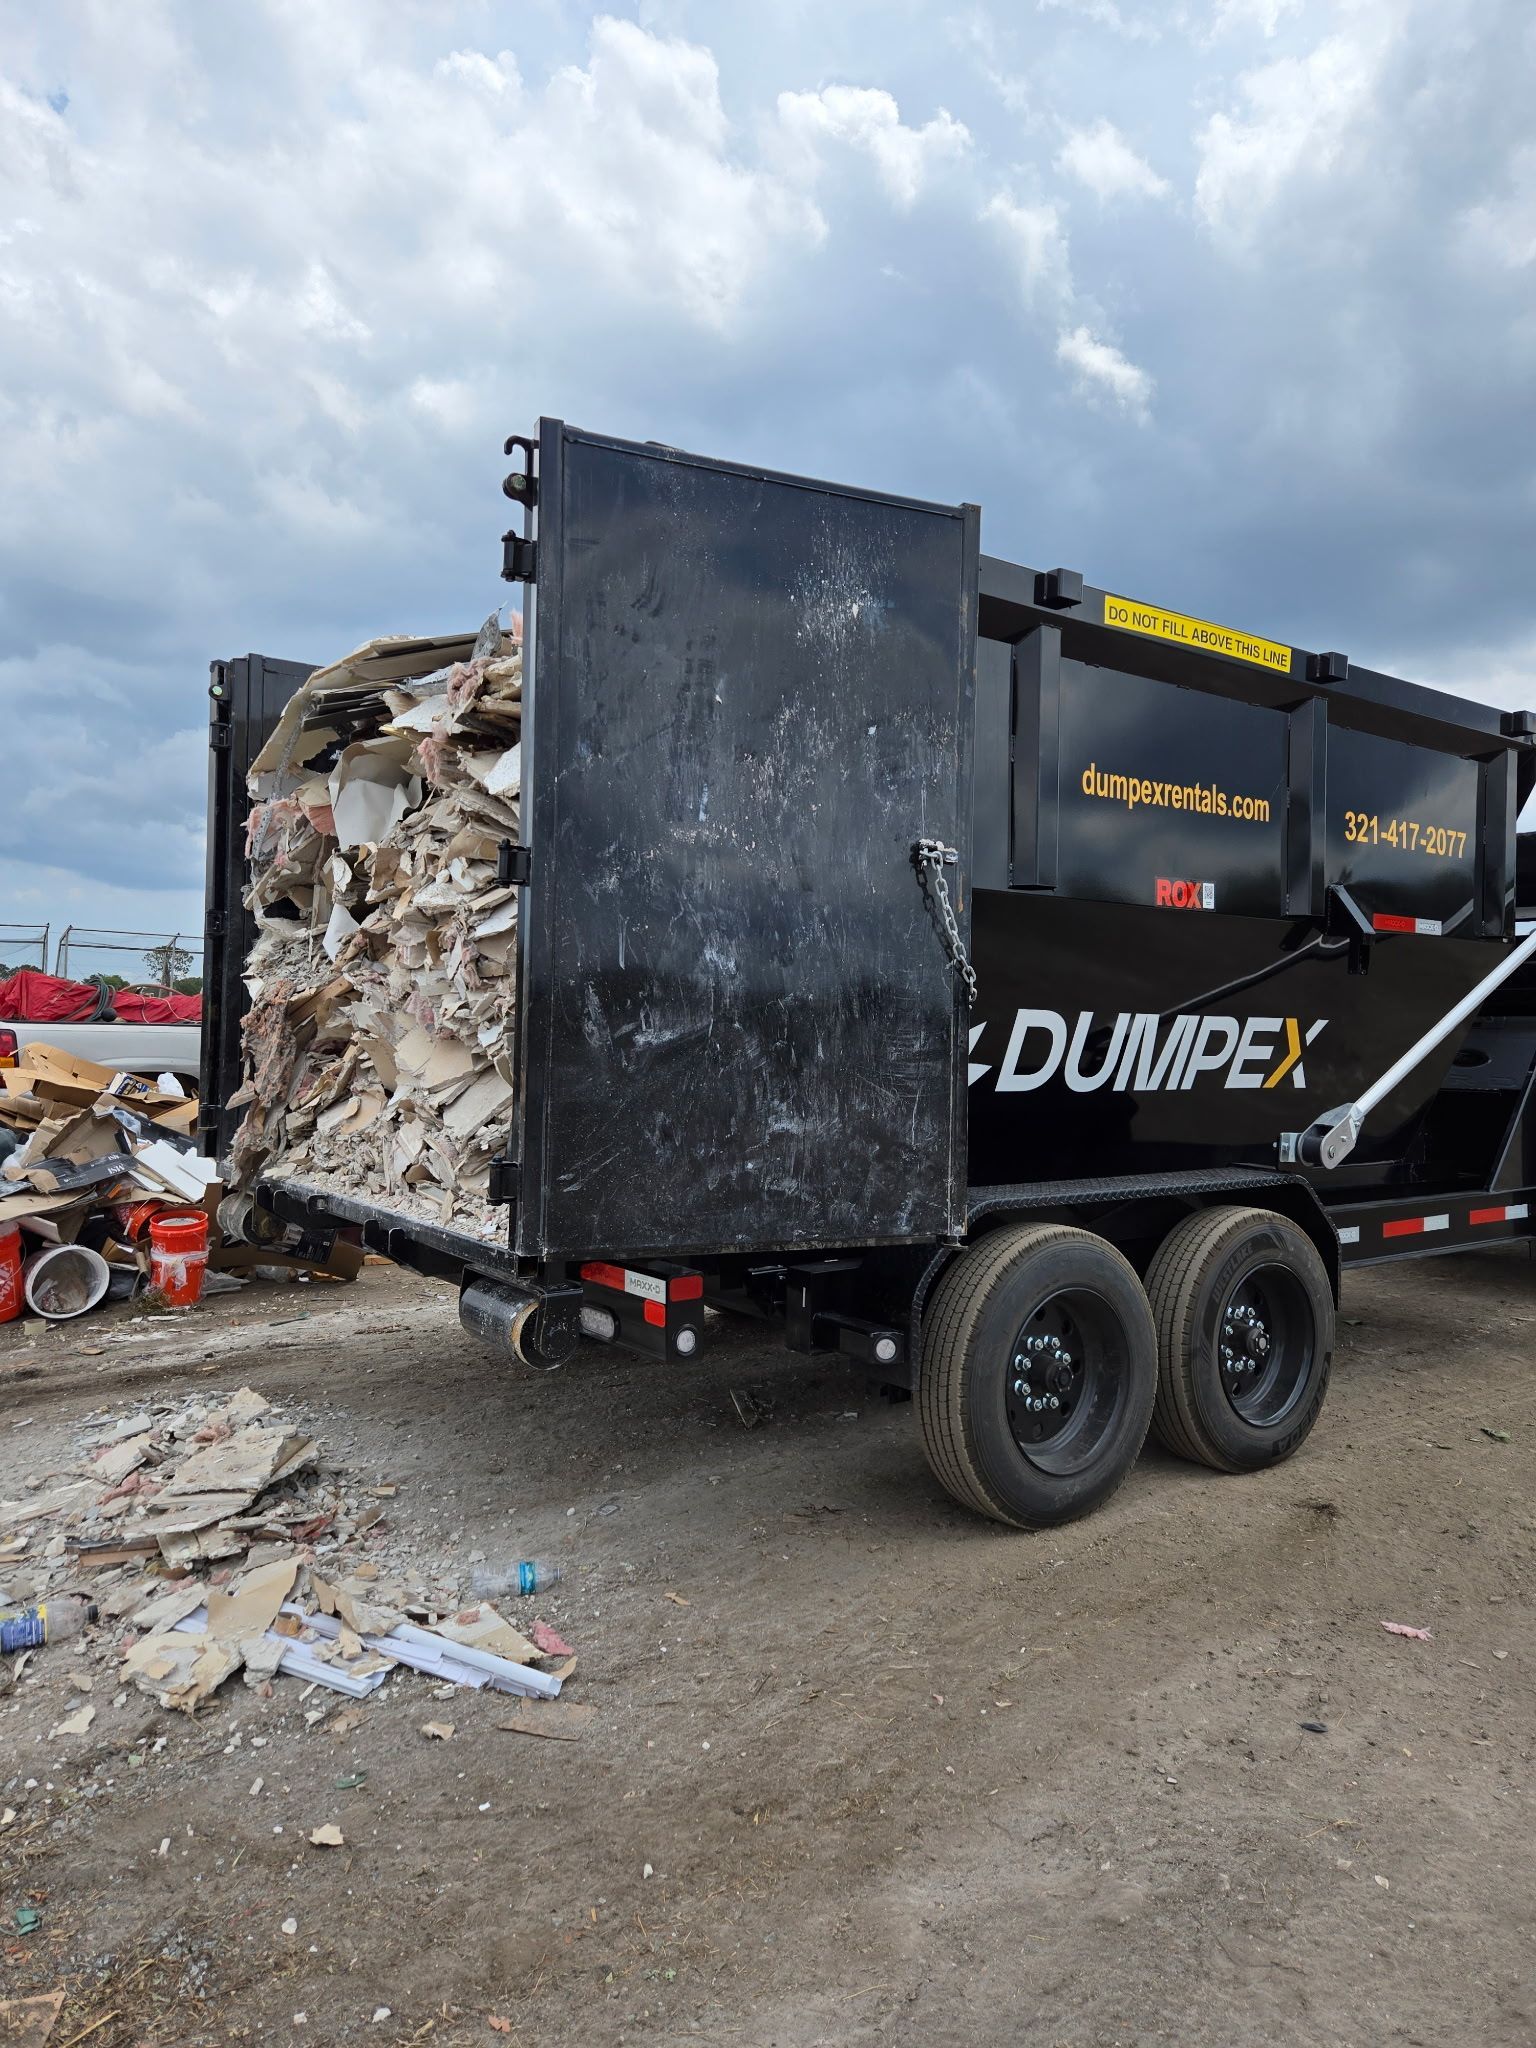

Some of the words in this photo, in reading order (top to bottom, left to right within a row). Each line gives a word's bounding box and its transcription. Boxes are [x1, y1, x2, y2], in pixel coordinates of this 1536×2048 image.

[1108, 605, 1129, 623] DO
[1132, 611, 1159, 630] NOT
[1162, 619, 1189, 639] FILL
[1191, 627, 1233, 651] ABOVE
[1234, 639, 1260, 659] THIS
[1262, 648, 1288, 668] LINE
[1081, 762, 1270, 822] dumpexrentals.com
[1344, 810, 1467, 858] 321-417-2077
[1156, 878, 1202, 909] ROX
[994, 1008, 1330, 1093] DUMPEX
[1212, 1242, 1254, 1305] WESTLAKE
